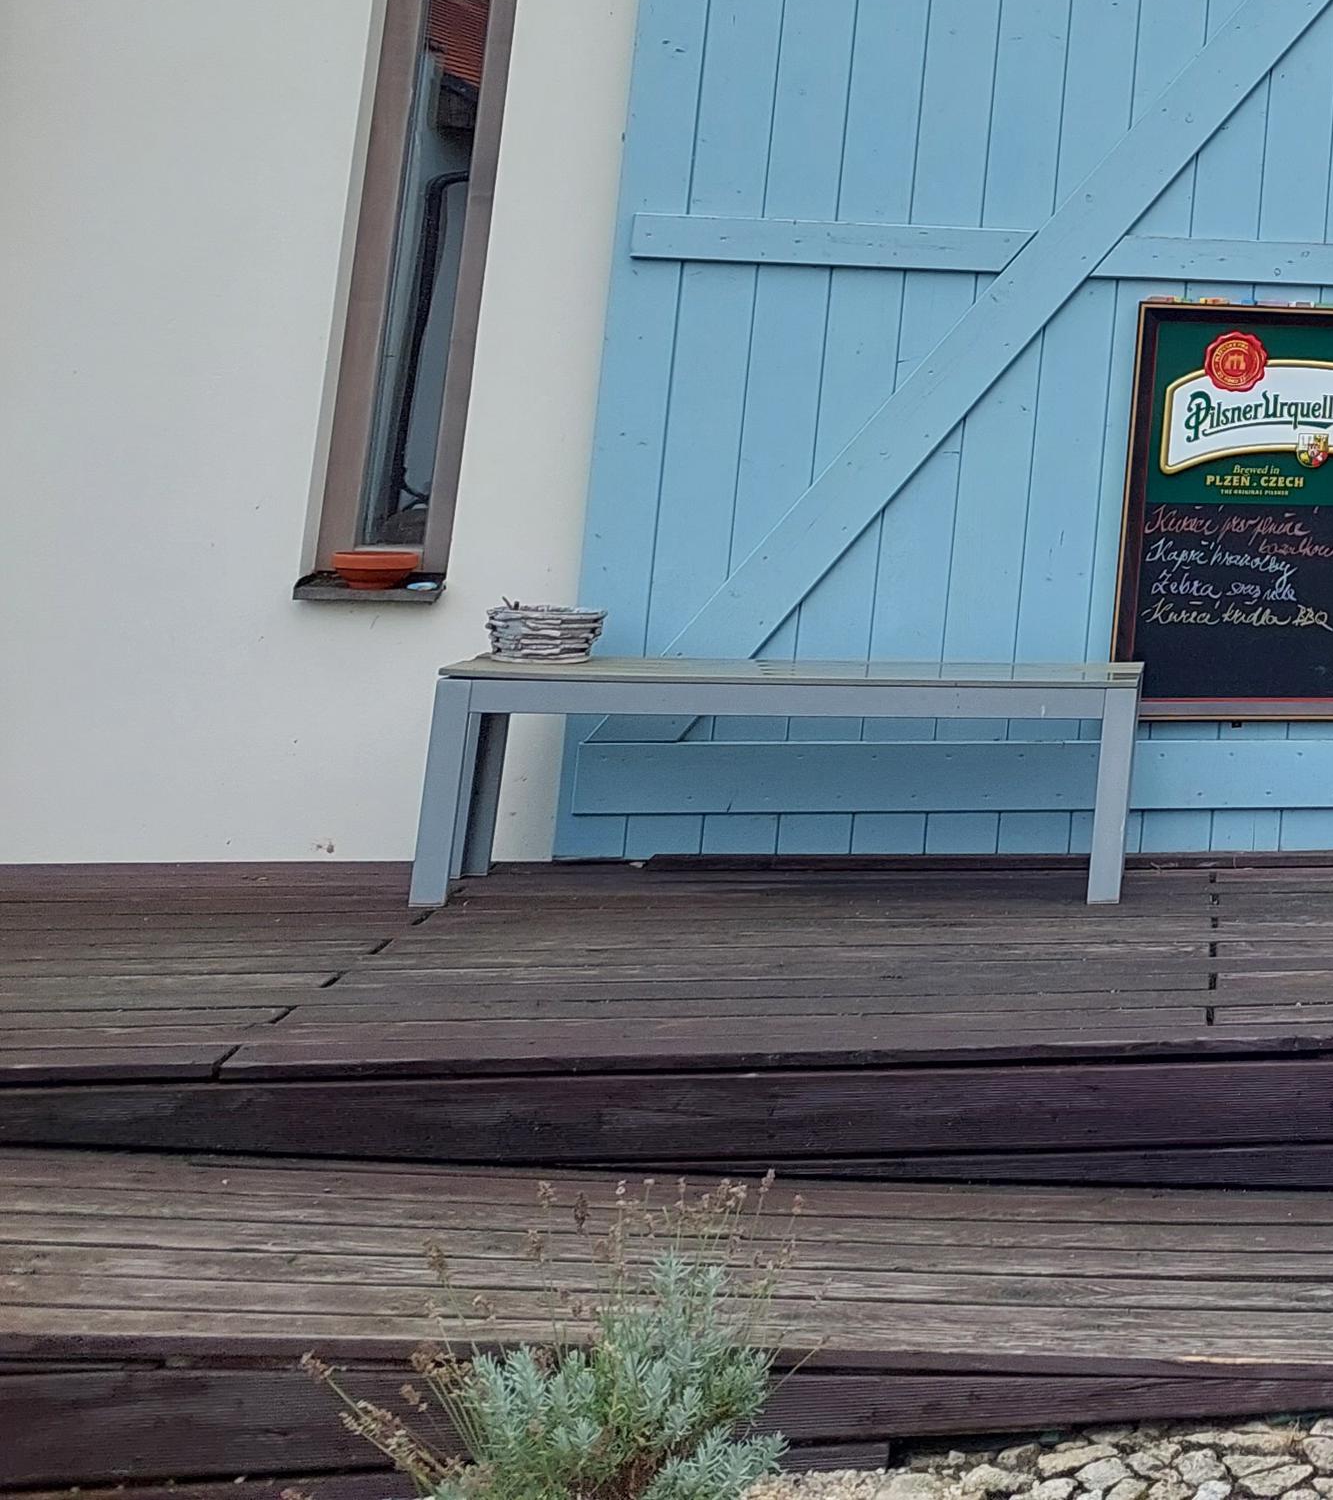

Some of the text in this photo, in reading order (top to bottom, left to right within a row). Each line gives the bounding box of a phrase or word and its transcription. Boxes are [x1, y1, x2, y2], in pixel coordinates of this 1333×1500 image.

[1233, 464, 1280, 474] Brewed in
[1260, 476, 1304, 487] CZECH
